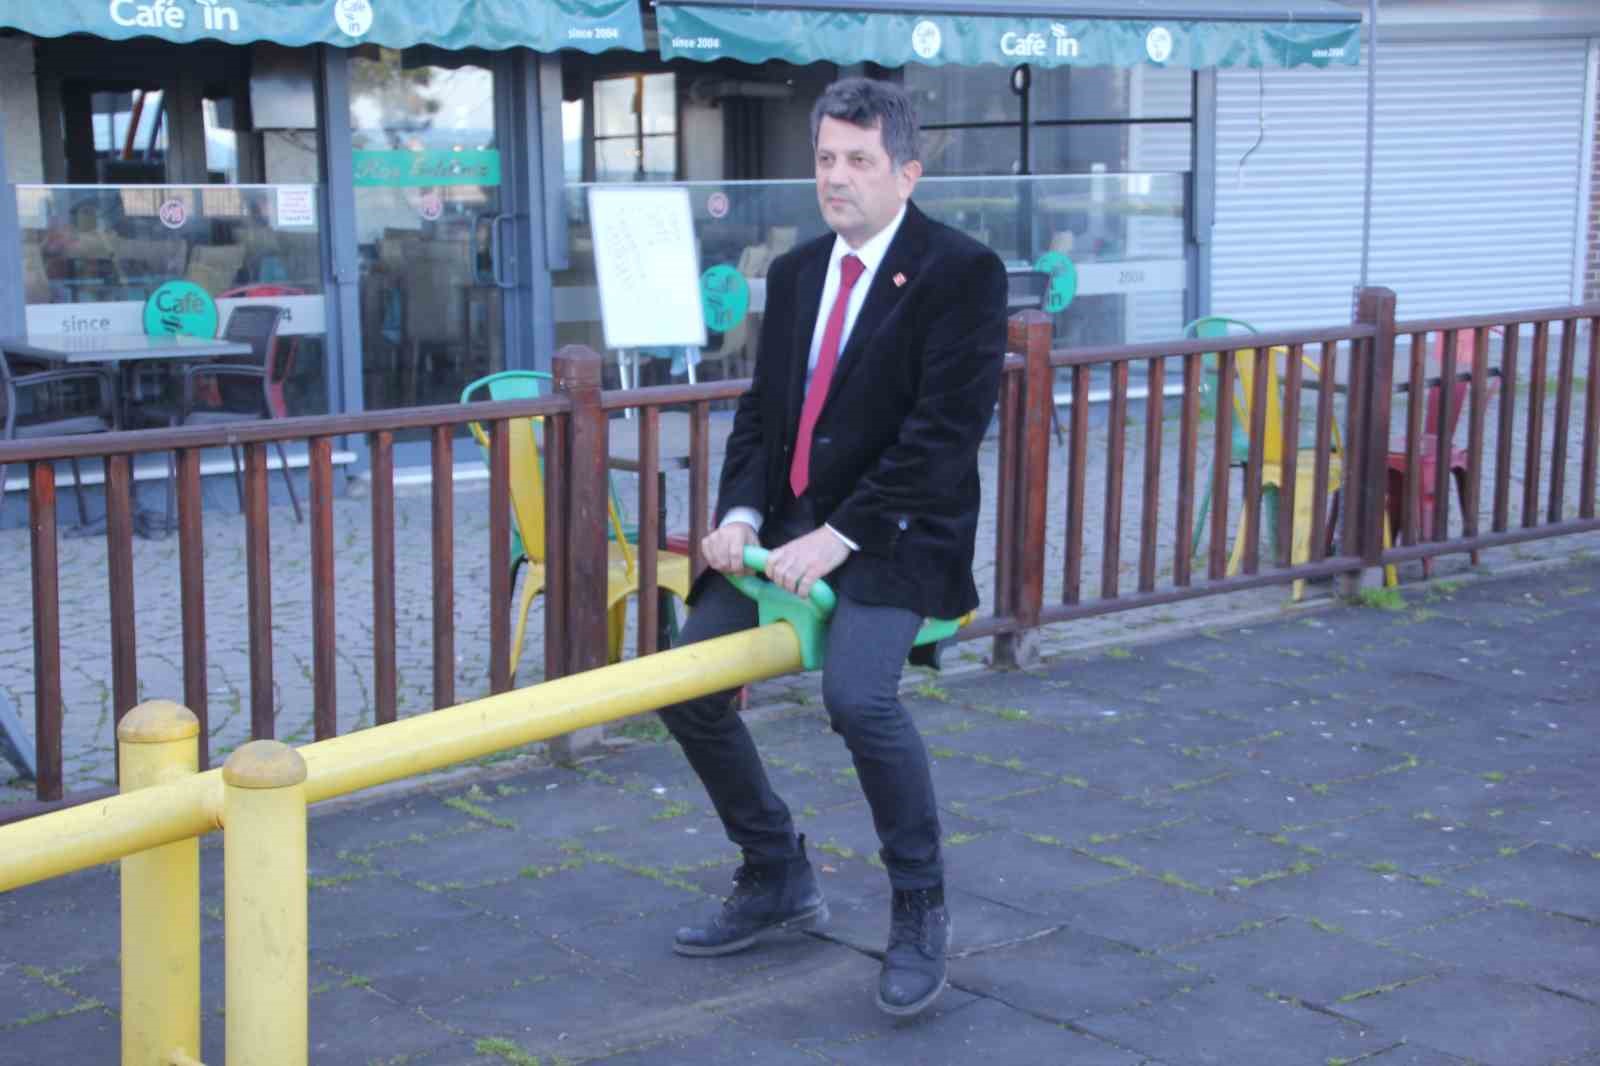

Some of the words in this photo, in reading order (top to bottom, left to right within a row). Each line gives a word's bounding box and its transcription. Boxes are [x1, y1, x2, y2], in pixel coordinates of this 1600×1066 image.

[110, 0, 185, 28] Café
[202, 1, 239, 31] in
[568, 28, 592, 39] since
[595, 27, 619, 39] 2004
[672, 38, 695, 48] since
[696, 37, 721, 48] 2004
[1000, 31, 1047, 57] Café
[1053, 28, 1079, 57] in
[61, 315, 112, 333] since
